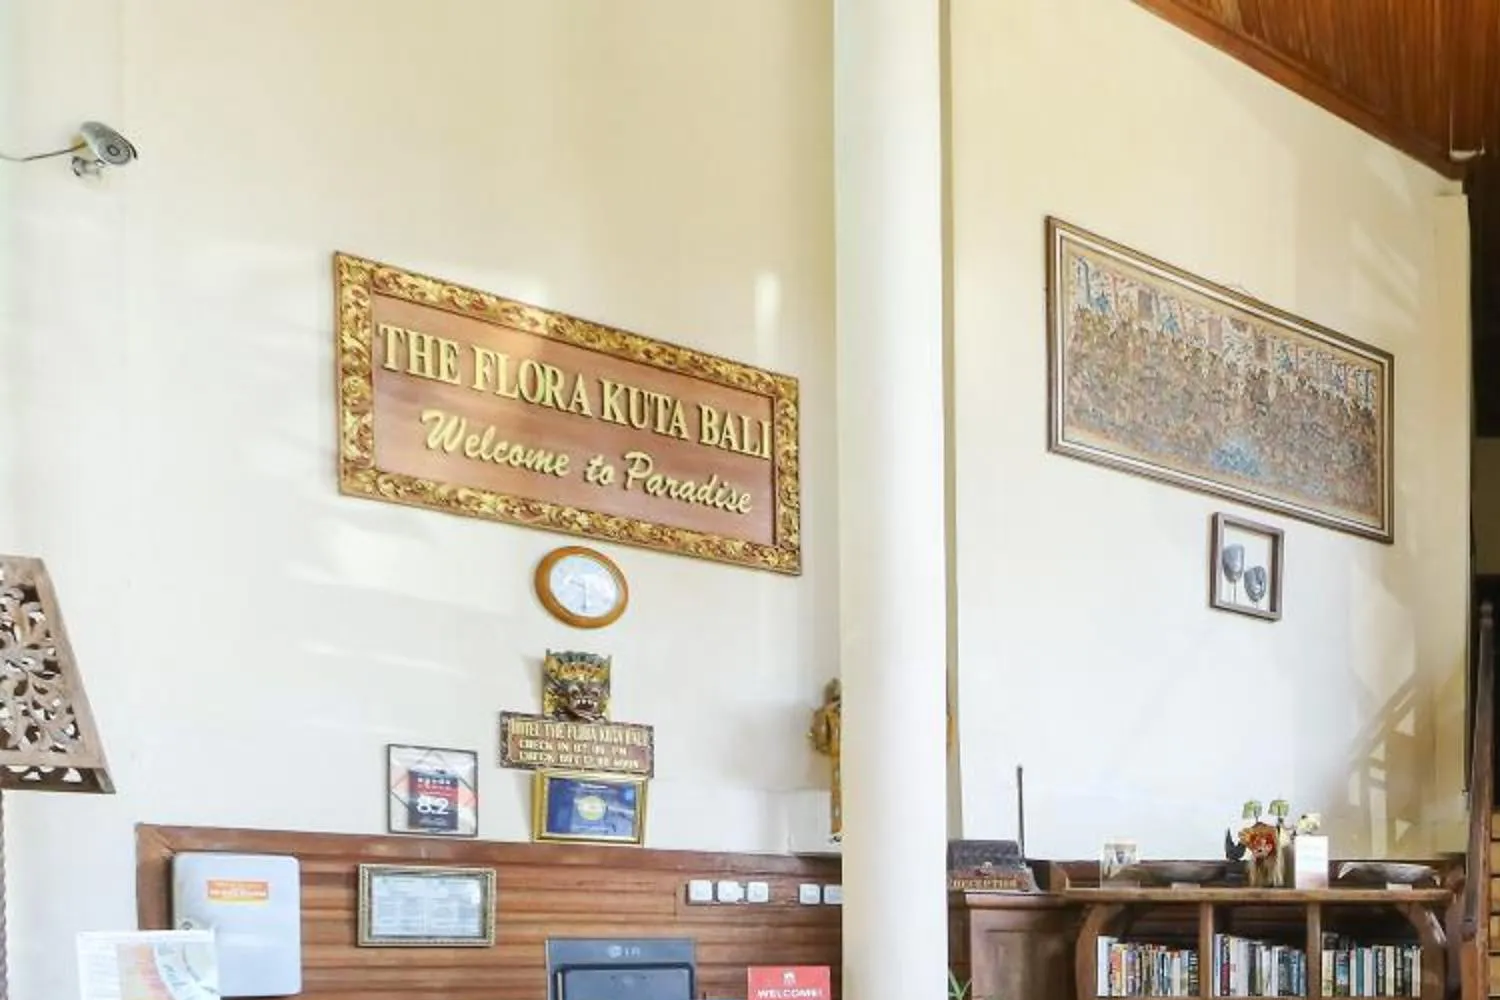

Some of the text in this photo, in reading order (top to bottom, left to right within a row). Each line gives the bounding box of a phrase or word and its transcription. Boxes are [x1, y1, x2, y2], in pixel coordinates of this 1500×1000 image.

[378, 323, 772, 459] THE FLORA KUTA BALI
[420, 408, 753, 513] Welcome to Paradise
